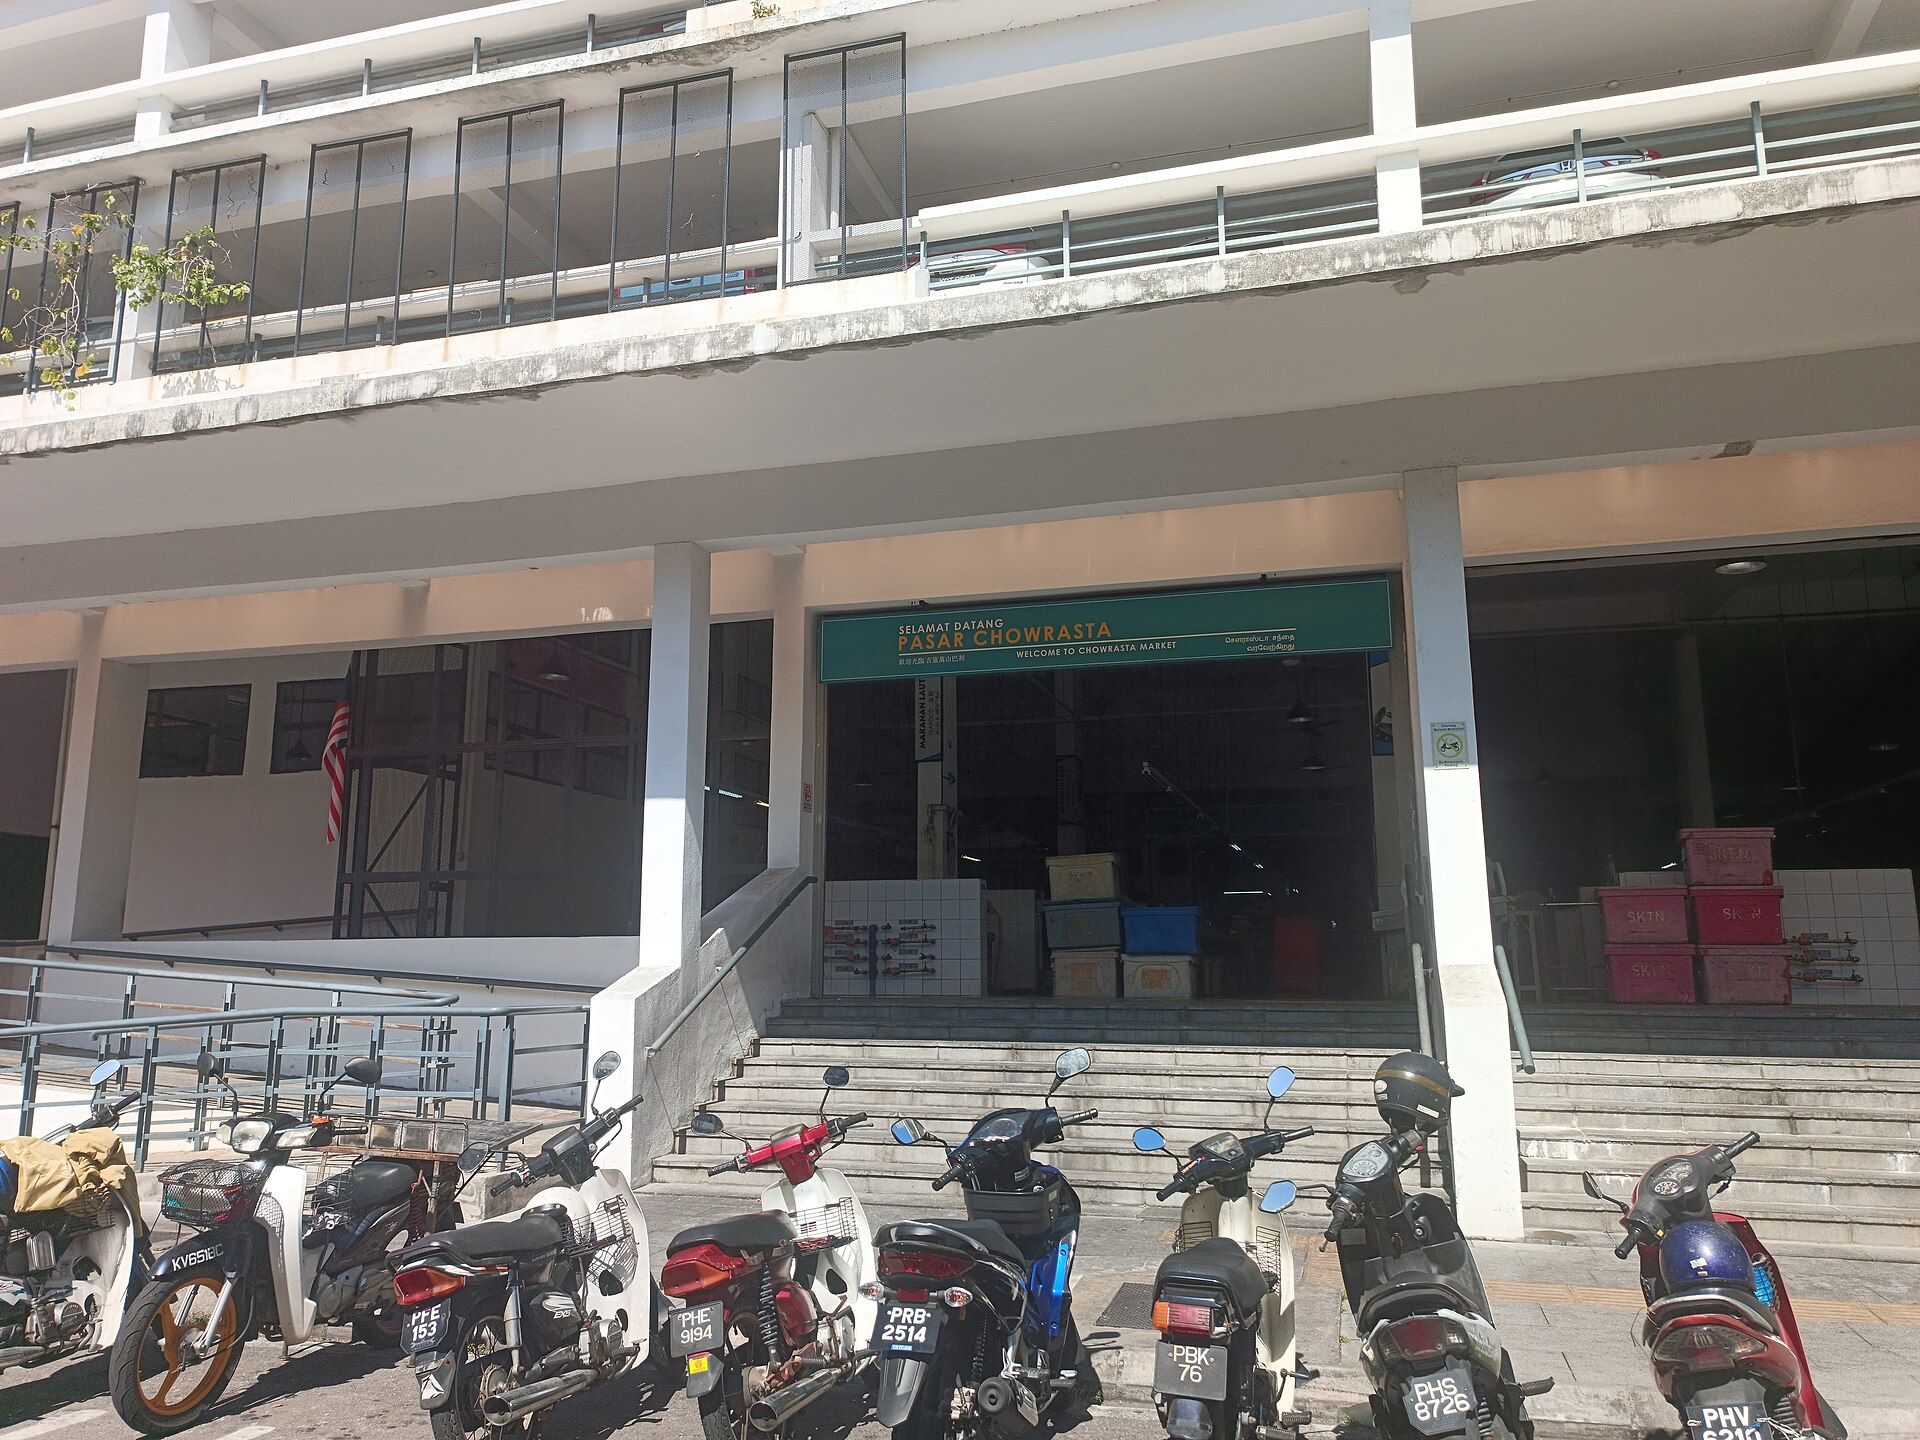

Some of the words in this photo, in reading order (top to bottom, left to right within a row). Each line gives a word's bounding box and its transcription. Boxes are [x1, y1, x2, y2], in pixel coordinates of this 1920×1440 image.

[898, 632, 964, 651] PASAR
[973, 622, 1111, 646] CHOWRASTA
[899, 622, 950, 635] SELAMAT
[954, 619, 1004, 631] DATANG
[1016, 648, 1060, 658] WELCOME
[1078, 644, 1136, 654] CHOWRASTA
[1139, 641, 1177, 651] MARKET
[918, 678, 926, 700] LAUT
[918, 702, 926, 749] MAKANAN
[1627, 910, 1665, 924] SKTN
[1722, 907, 1761, 921] SKN
[411, 1303, 441, 1326] PFE
[553, 1309, 571, 1319] EX5
[682, 1307, 711, 1328] PHE
[889, 1306, 926, 1324] PRB
[412, 1320, 437, 1342] 153
[680, 1324, 713, 1344] 9194
[881, 1324, 927, 1343] 2514
[1173, 1345, 1210, 1366] PBK
[1178, 1363, 1203, 1383] 76
[1414, 1377, 1458, 1403] PHS
[1414, 1393, 1471, 1421] 8726
[1702, 1405, 1749, 1428] PHV
